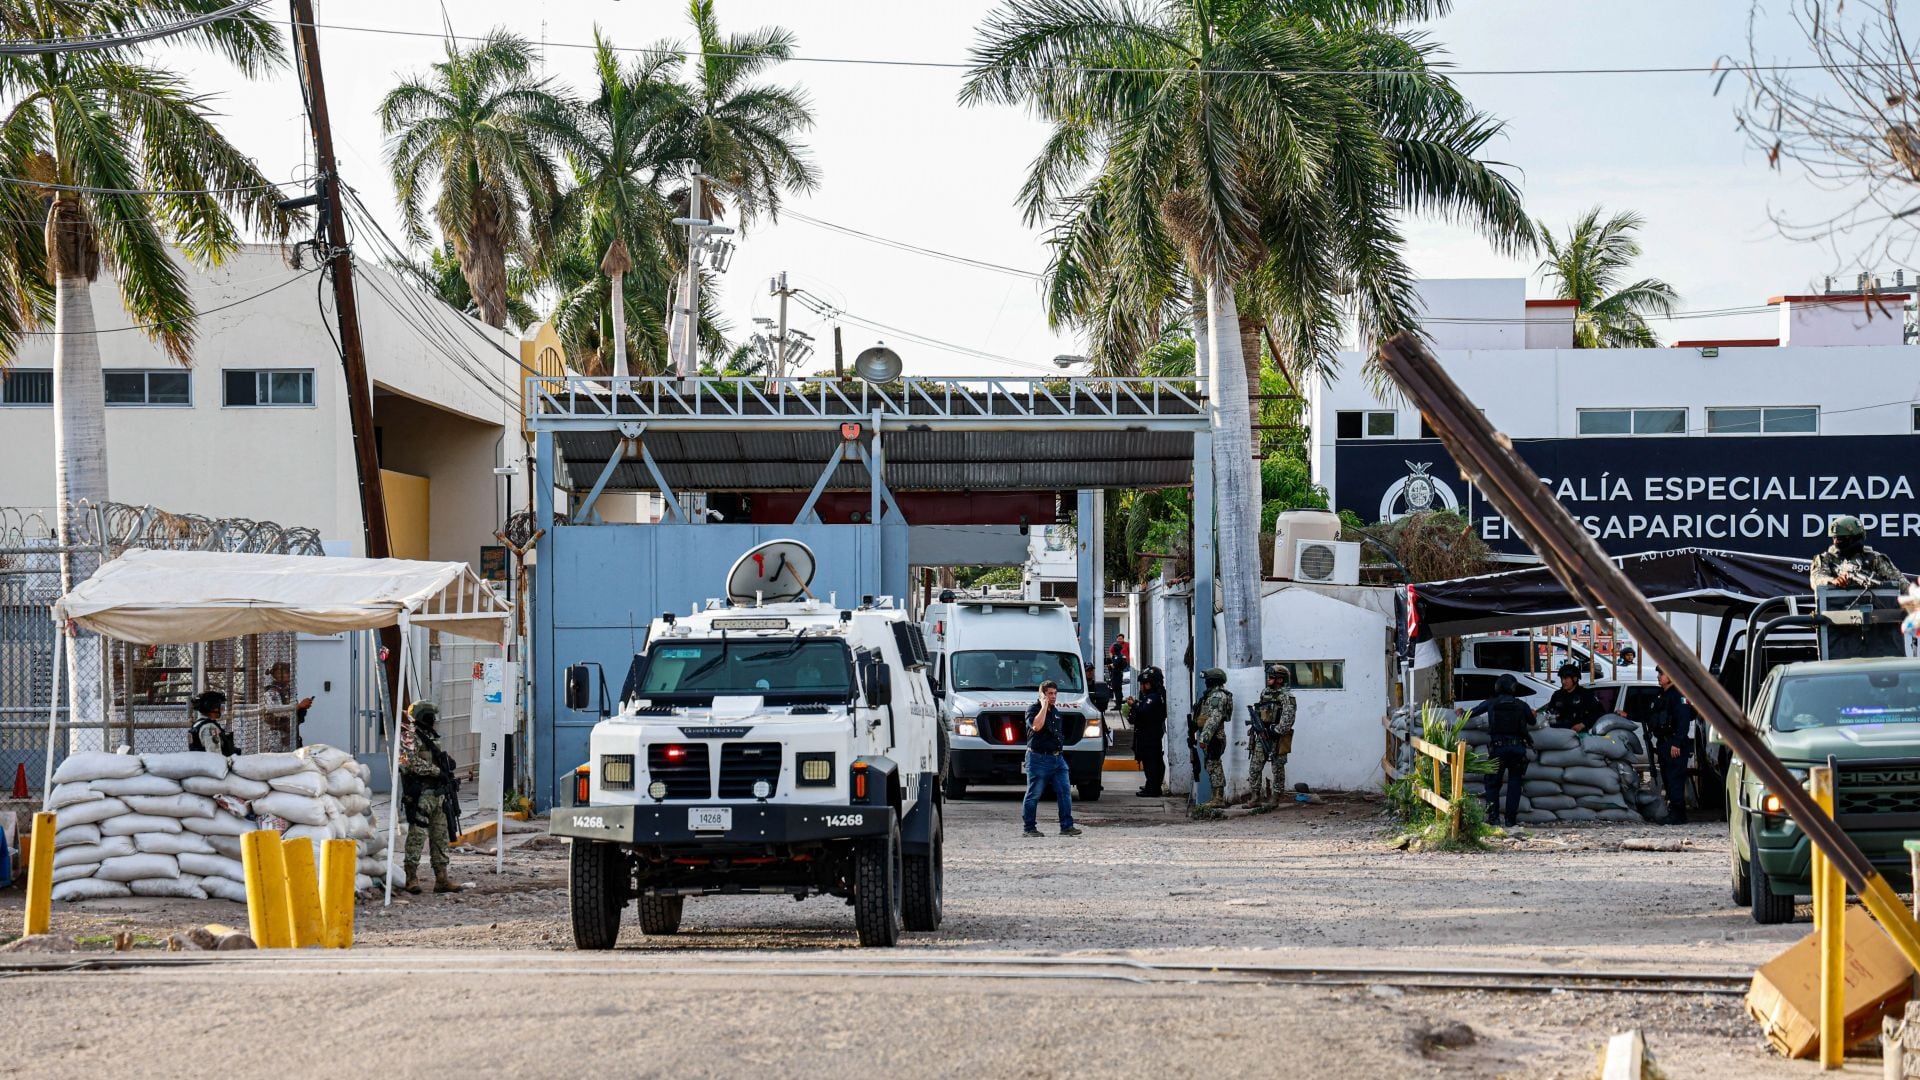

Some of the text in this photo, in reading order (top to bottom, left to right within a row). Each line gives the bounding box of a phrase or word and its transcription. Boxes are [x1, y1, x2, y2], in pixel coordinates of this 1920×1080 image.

[1645, 476, 1914, 500] ESPECIALIZADA
[1573, 508, 1789, 538] SAPARICIÓN
[572, 815, 603, 828] 14268
[700, 814, 722, 823] 14268
[826, 814, 864, 828] 14268
